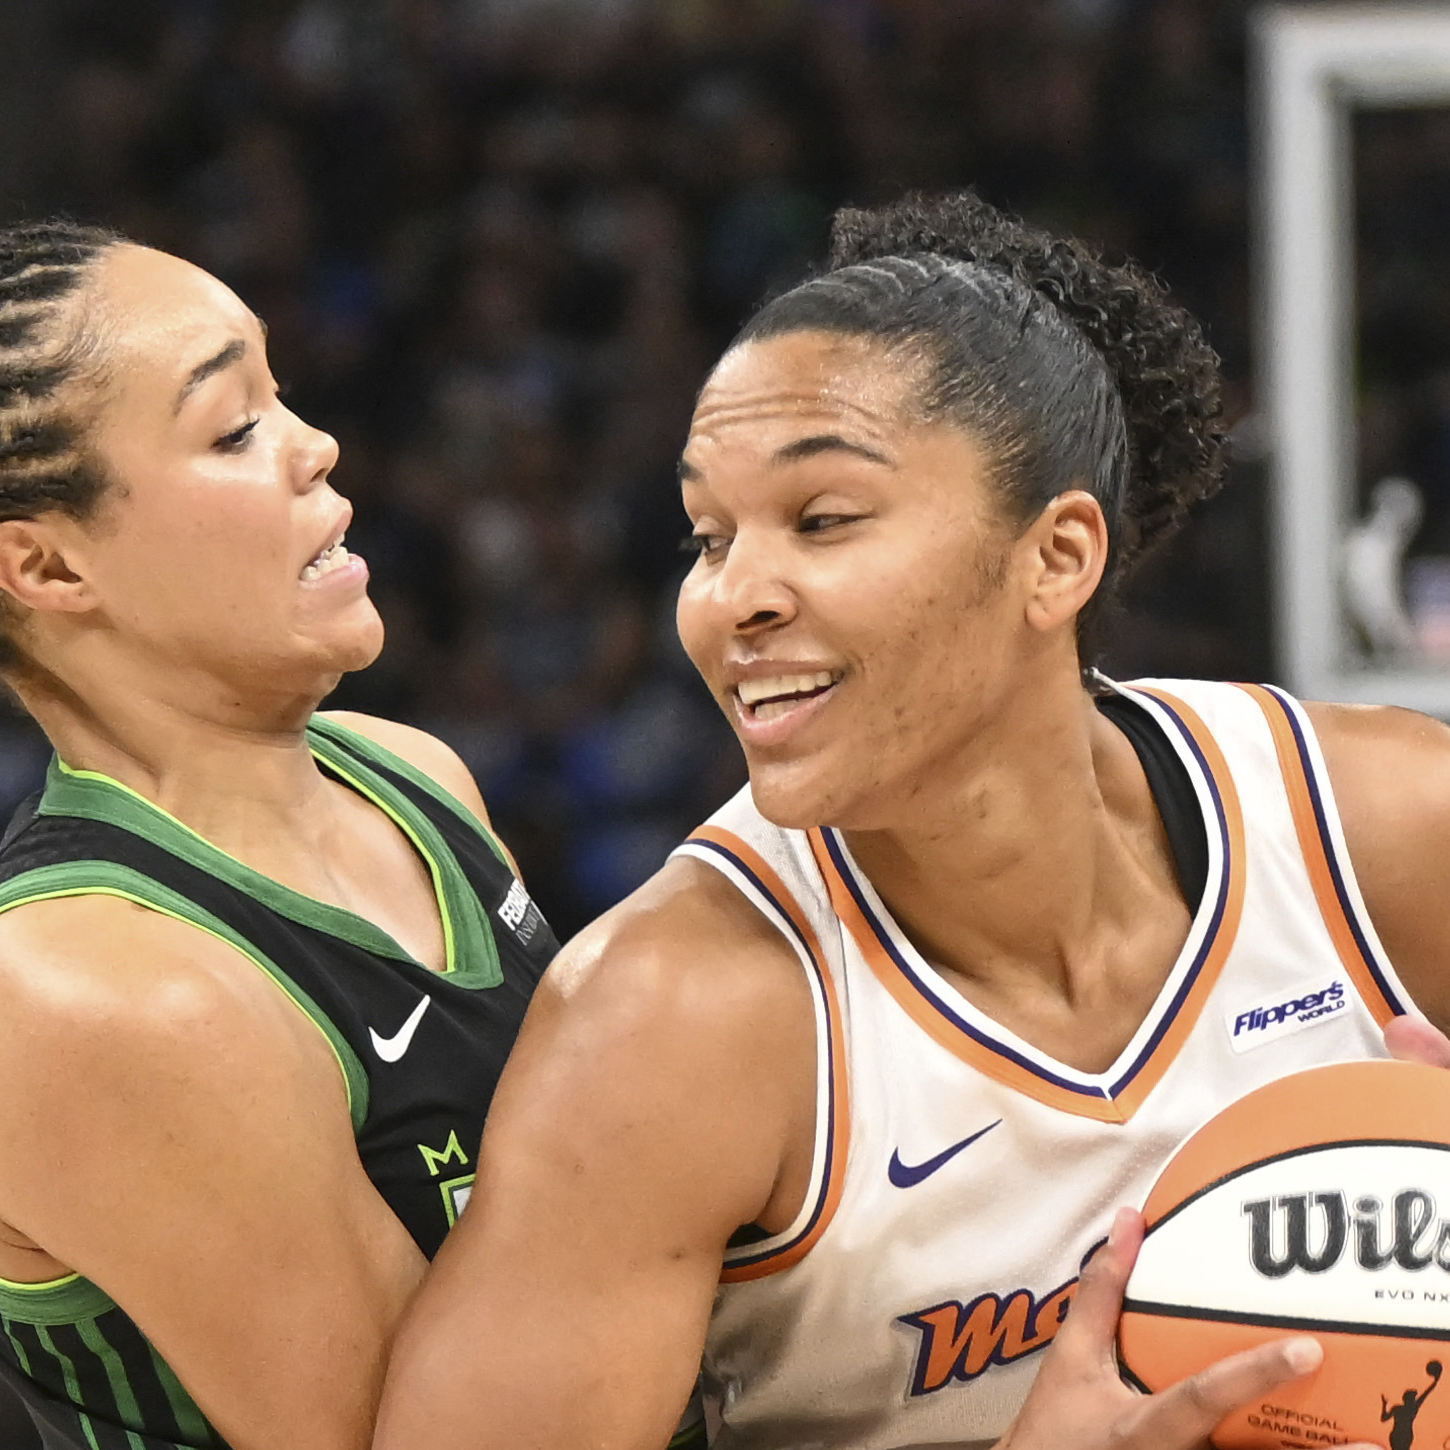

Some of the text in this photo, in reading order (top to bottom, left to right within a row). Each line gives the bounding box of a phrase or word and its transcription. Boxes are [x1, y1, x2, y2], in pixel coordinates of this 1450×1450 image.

[1297, 1000, 1346, 1023] WORLD
[1374, 1288, 1415, 1301] EVO
[1247, 1413, 1302, 1437] GAME
[1260, 1403, 1345, 1432] OFFICIAL
